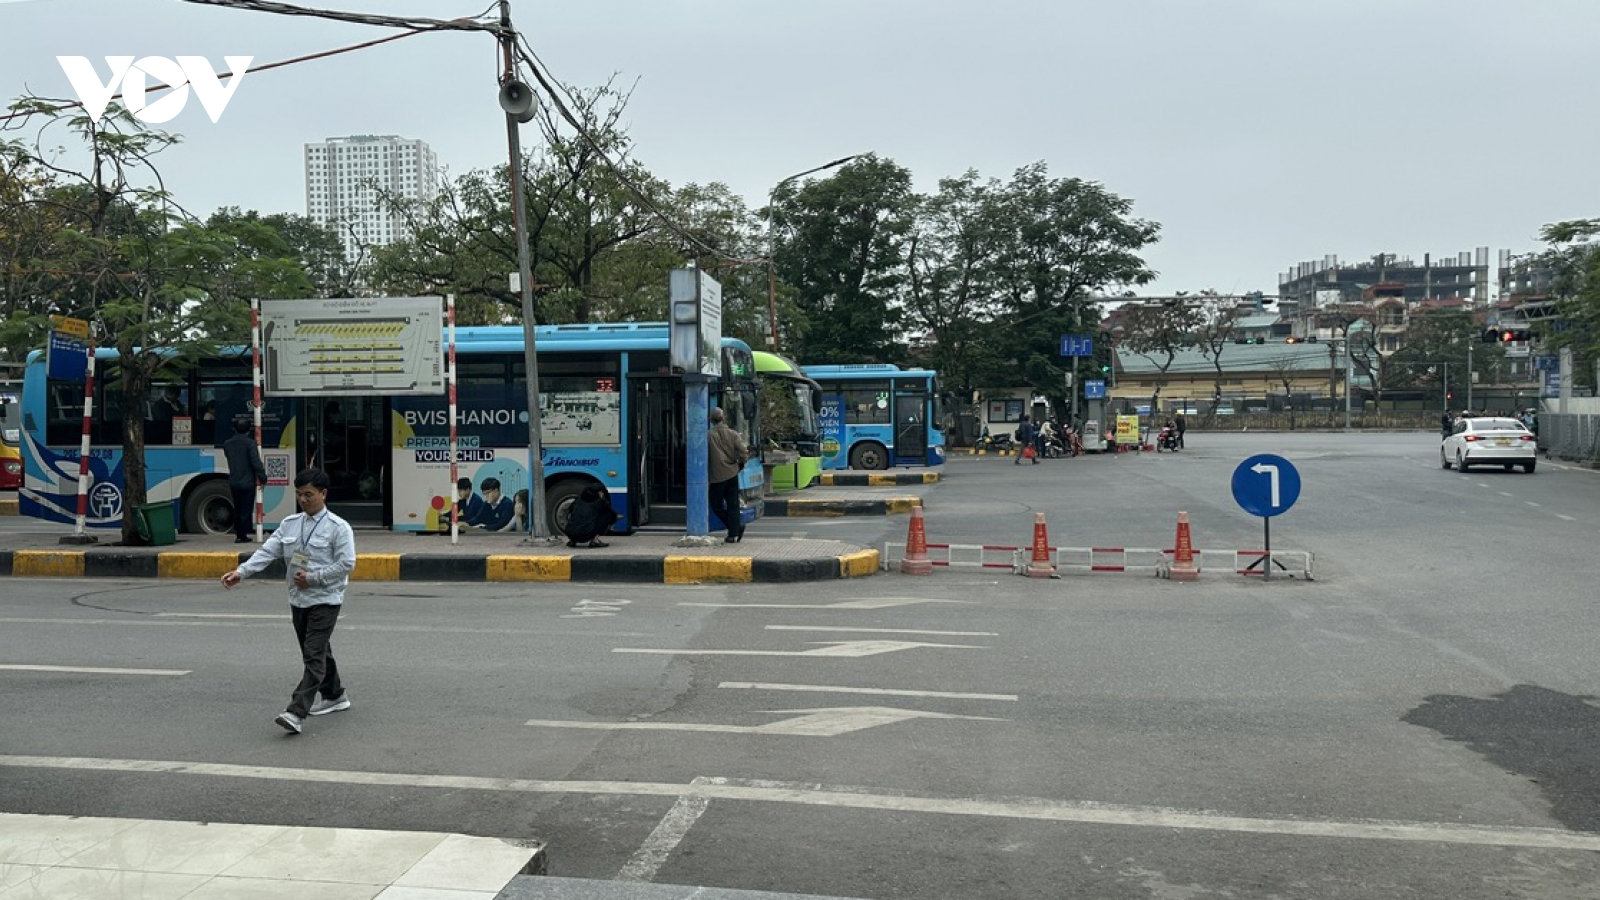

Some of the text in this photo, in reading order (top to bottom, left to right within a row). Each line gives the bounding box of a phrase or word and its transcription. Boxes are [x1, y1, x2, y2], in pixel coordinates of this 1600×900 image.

[405, 409, 516, 425] BVIS HANOI
[406, 436, 479, 448] PREPAING
[416, 449, 493, 461] YOUR CHILD
